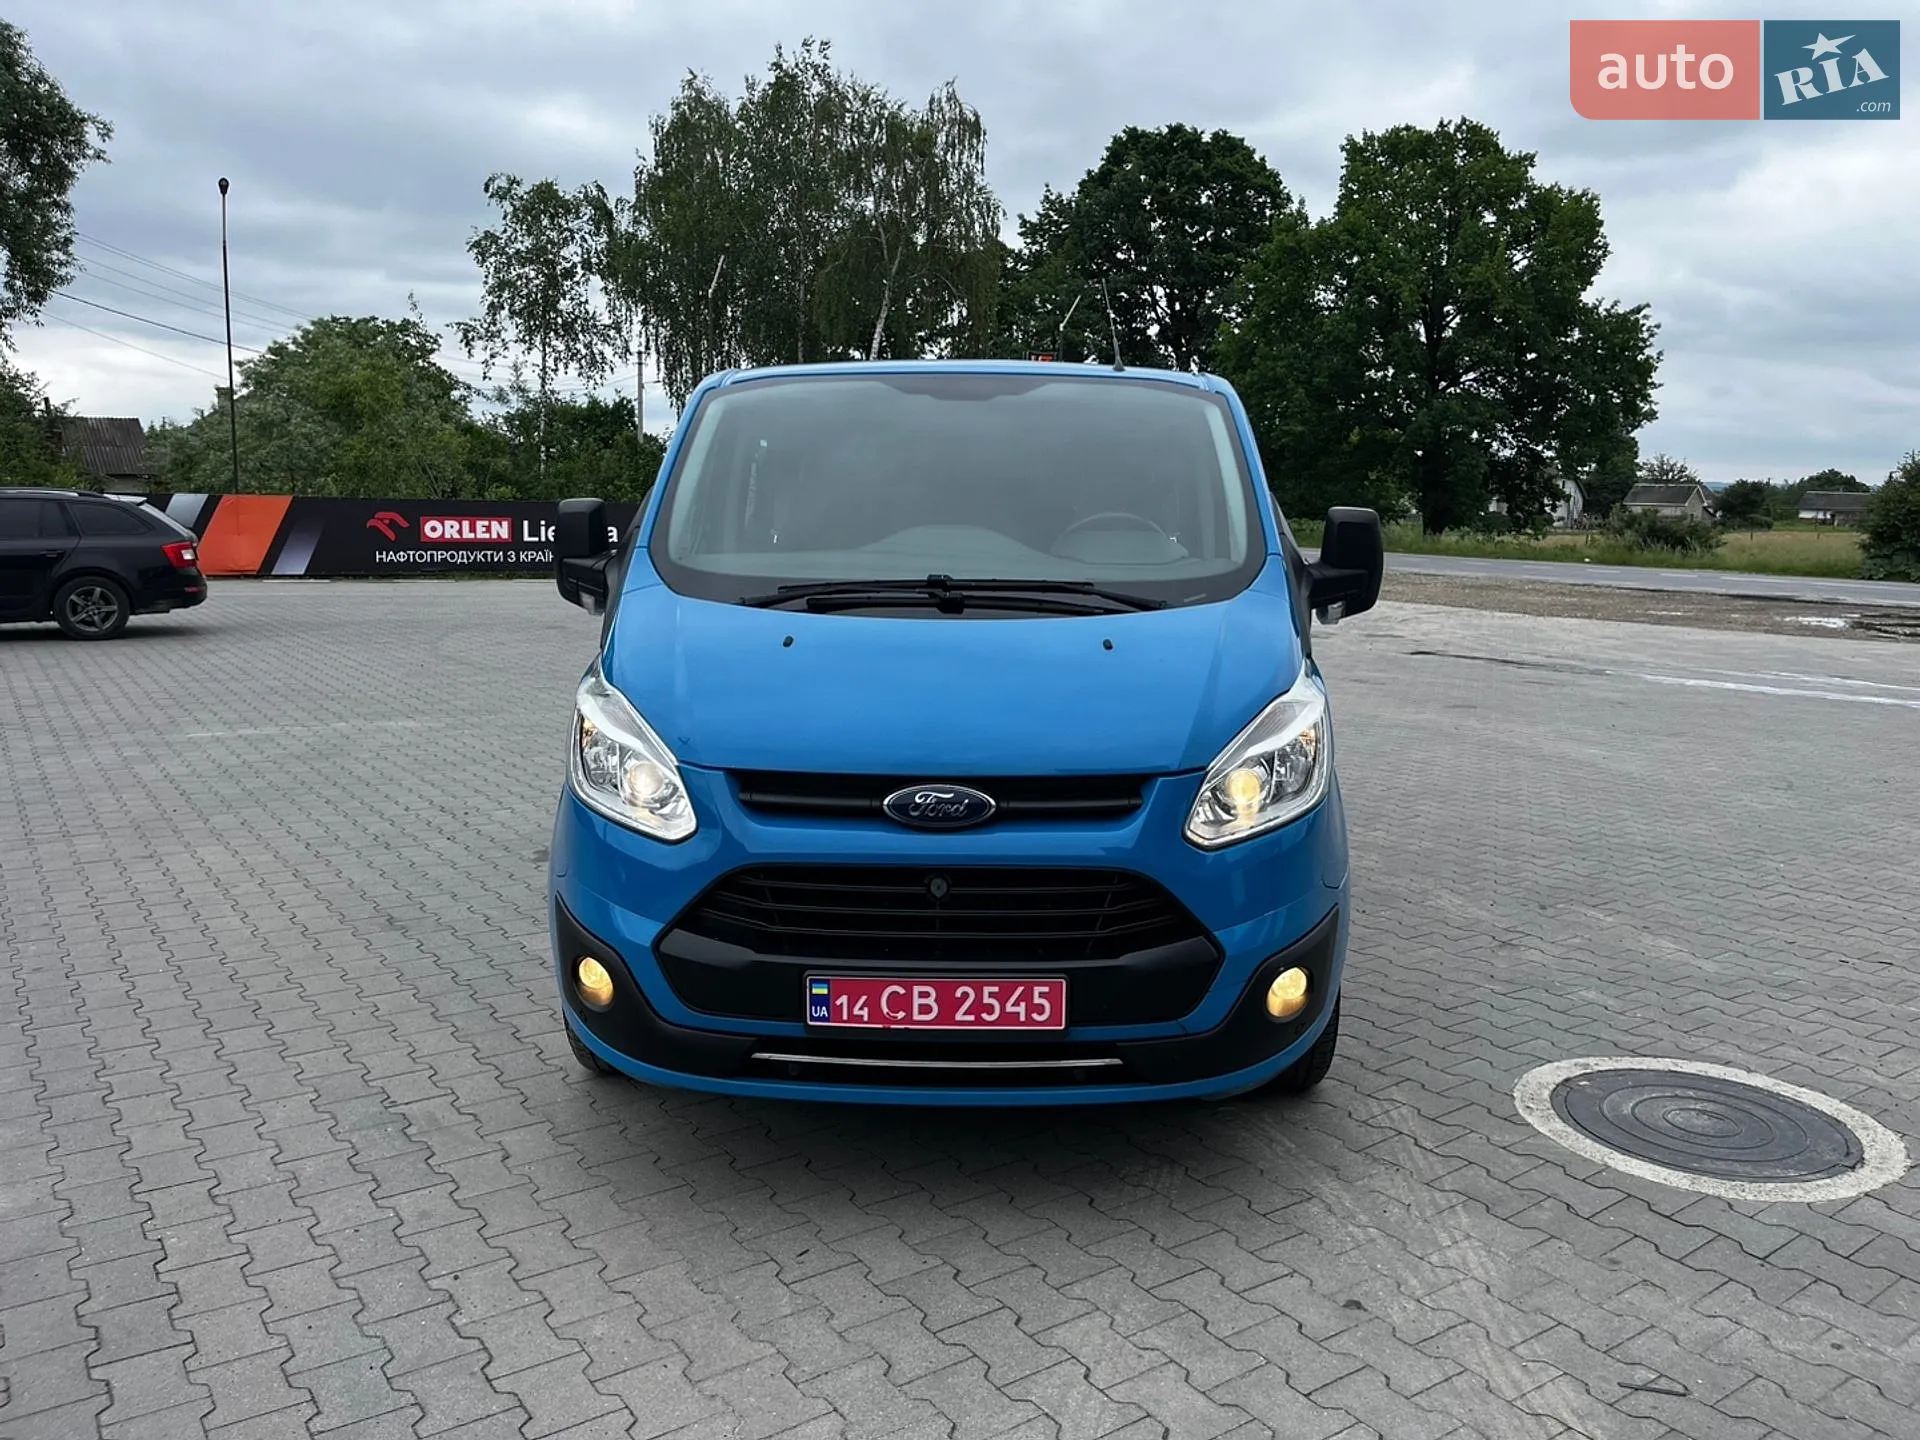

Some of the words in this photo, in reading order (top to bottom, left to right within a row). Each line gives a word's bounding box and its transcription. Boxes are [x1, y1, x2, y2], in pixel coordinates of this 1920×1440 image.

[423, 520, 508, 539] ORLEN
[376, 551, 504, 564] НАФТОПРОДУКТИ
[909, 791, 969, 816] Ford
[811, 1007, 829, 1018] UA
[954, 986, 1051, 1023] 2545
